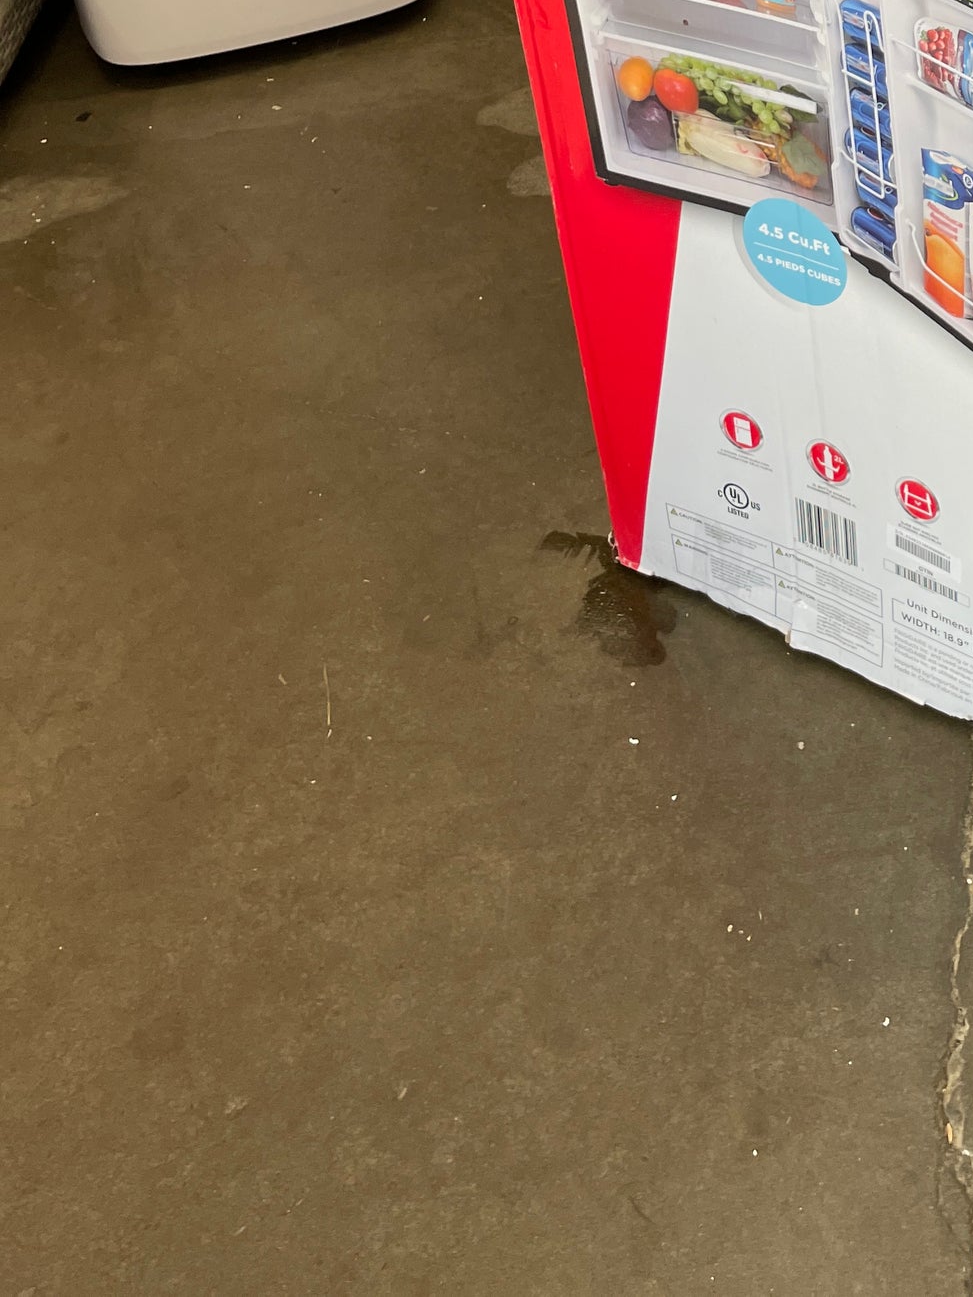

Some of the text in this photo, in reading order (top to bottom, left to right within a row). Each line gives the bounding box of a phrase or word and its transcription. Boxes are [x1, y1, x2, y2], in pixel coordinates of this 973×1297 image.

[758, 223, 831, 256] 4.5 Cu.Ft
[757, 253, 841, 287] 4.5 PIEDS CUBES
[727, 506, 750, 520] LISTED
[906, 598, 928, 616] Unit
[900, 613, 942, 637] WIDTH:
